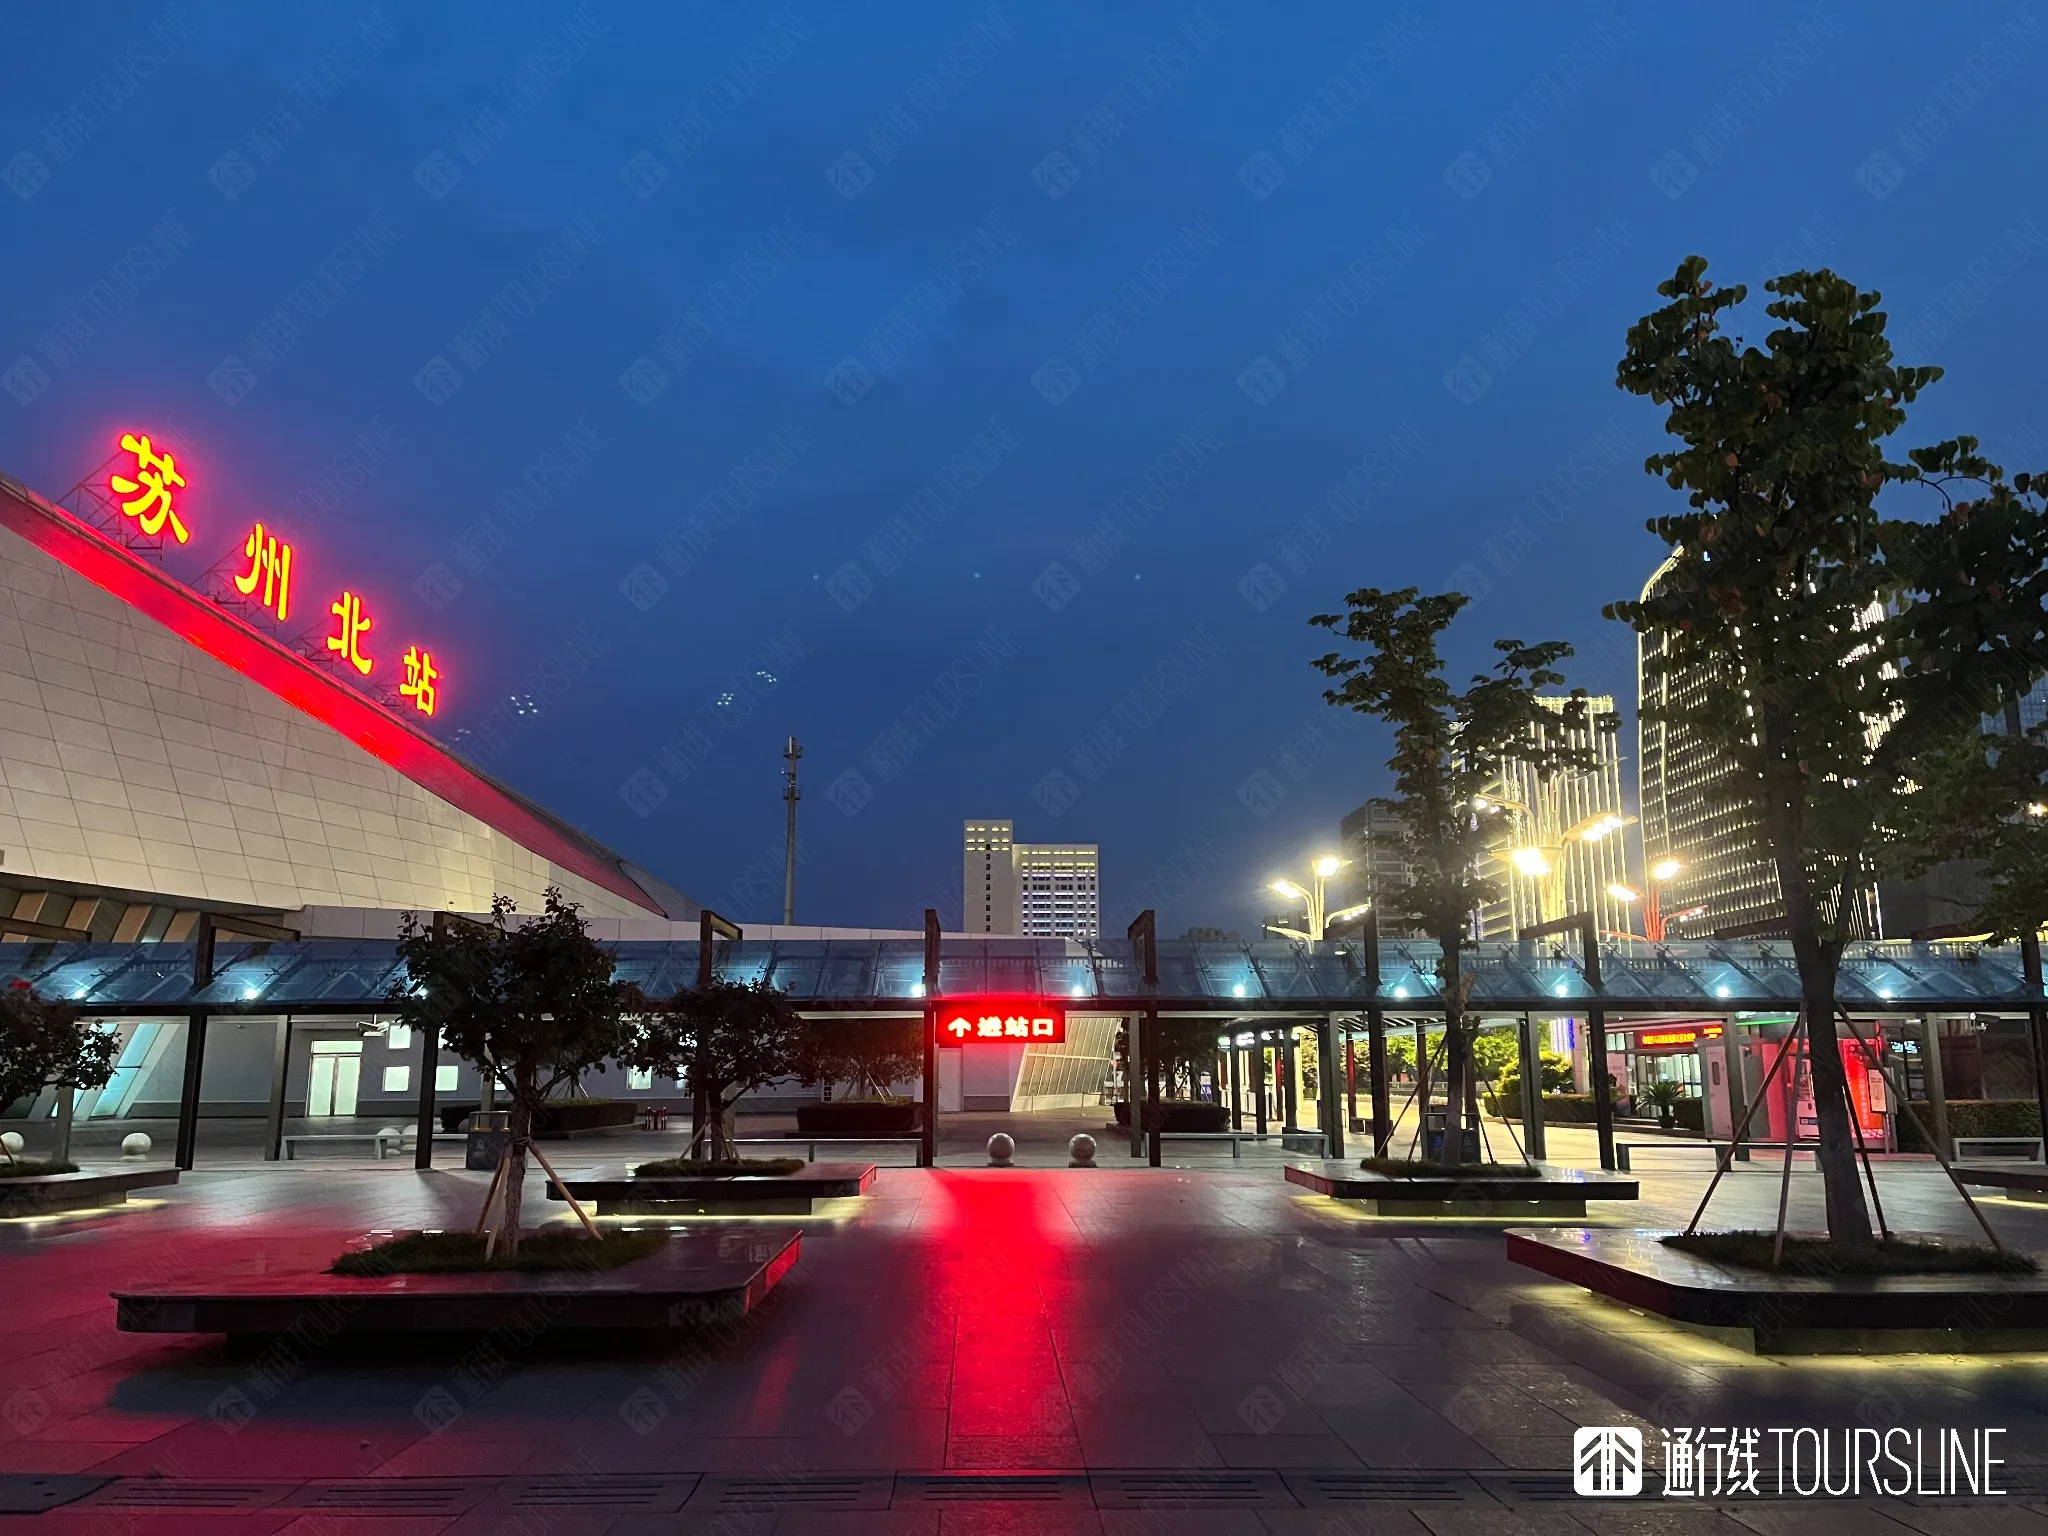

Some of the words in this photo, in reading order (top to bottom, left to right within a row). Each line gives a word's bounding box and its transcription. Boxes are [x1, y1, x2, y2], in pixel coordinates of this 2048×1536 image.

[111, 434, 437, 716] 苏州北站
[977, 1016, 1053, 1038] 进站口
